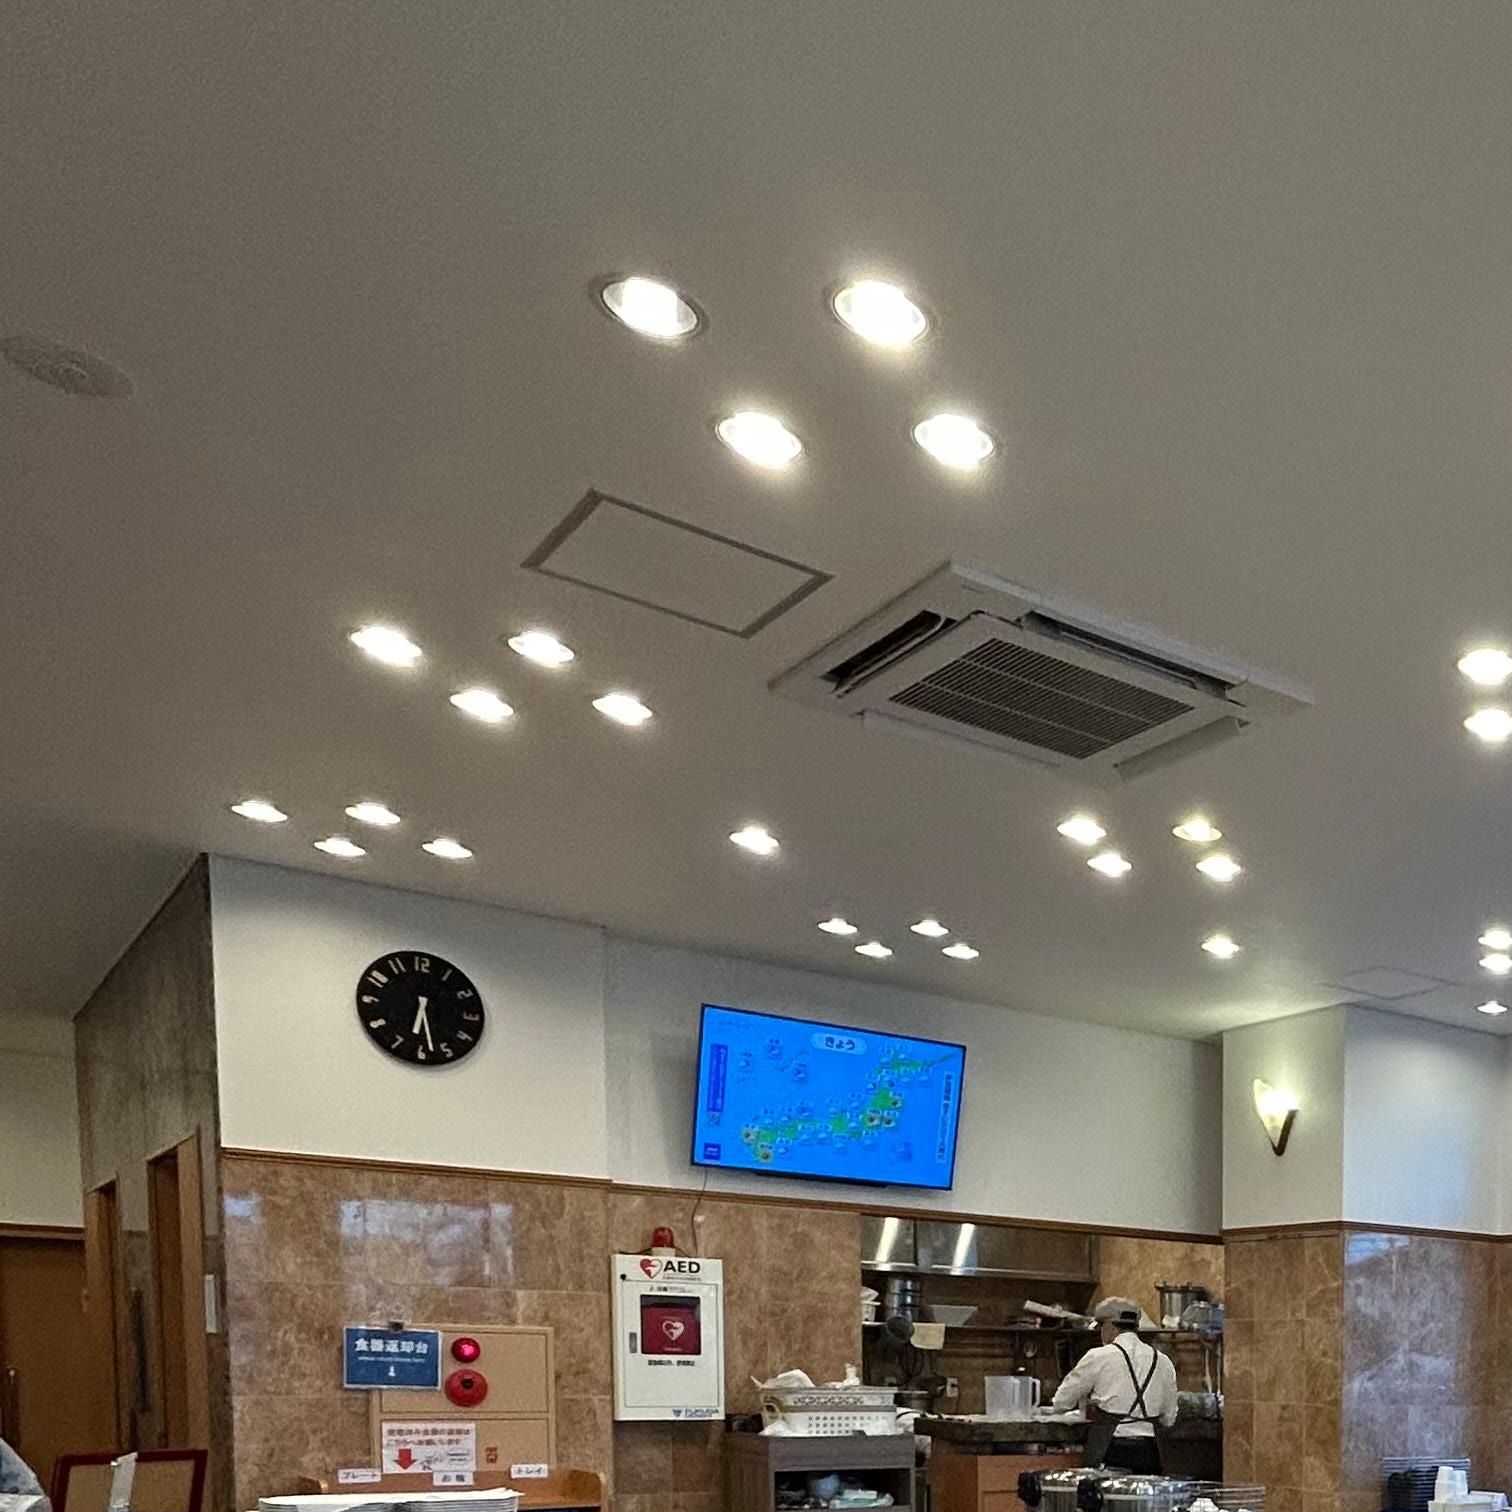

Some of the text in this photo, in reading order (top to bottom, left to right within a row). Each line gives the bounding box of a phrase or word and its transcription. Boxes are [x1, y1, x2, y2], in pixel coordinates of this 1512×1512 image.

[388, 957, 406, 974] 11
[415, 956, 430, 973] 12
[366, 970, 388, 988] 10
[442, 969, 452, 981] 1
[362, 995, 379, 1003] 9
[457, 989, 474, 999] 2
[463, 1011, 480, 1021] 3
[370, 1018, 386, 1029] 8
[391, 1035, 404, 1048] 7
[456, 1030, 473, 1041] 4
[417, 1045, 426, 1060] 6
[440, 1042, 454, 1057] 5
[663, 1260, 701, 1273] AED
[355, 1338, 429, 1354] 食器返却台
